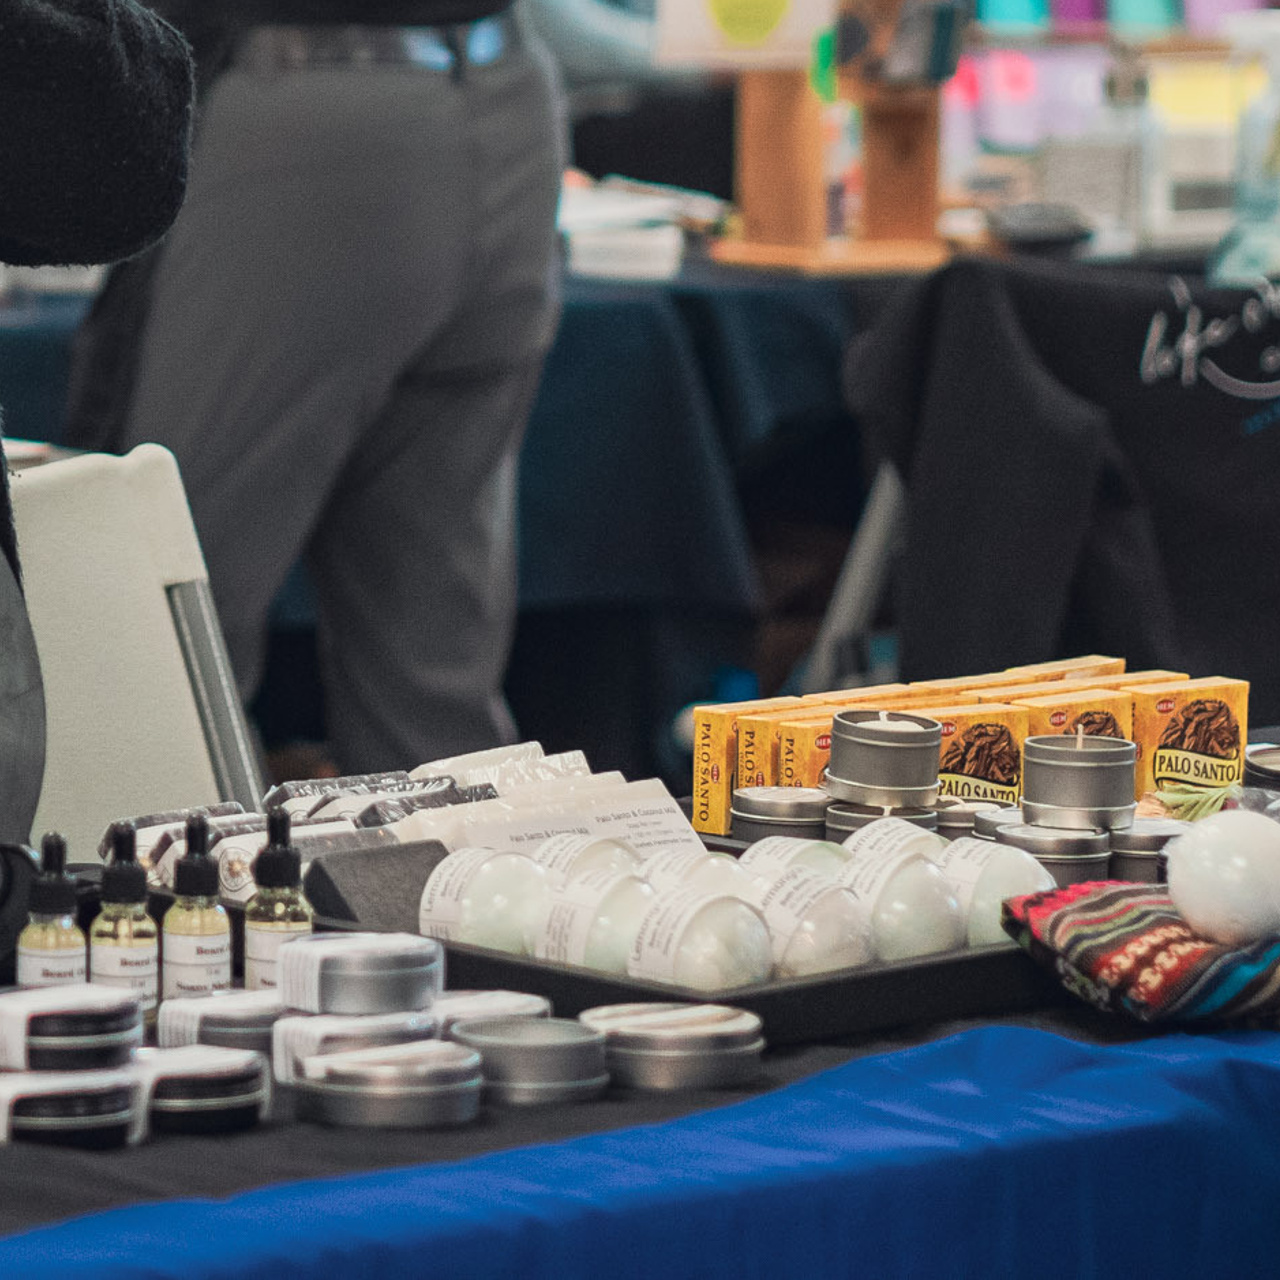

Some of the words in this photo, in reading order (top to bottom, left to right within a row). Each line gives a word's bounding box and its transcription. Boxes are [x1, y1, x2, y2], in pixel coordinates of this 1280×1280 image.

[701, 723, 712, 763] PALO
[745, 730, 755, 771] PALO
[784, 738, 795, 779] PALO
[1158, 755, 1191, 775] PALO
[1194, 760, 1236, 782] SANTO
[699, 767, 710, 822] SANTO
[938, 779, 971, 797] PALO
[974, 784, 1016, 804] SANTO
